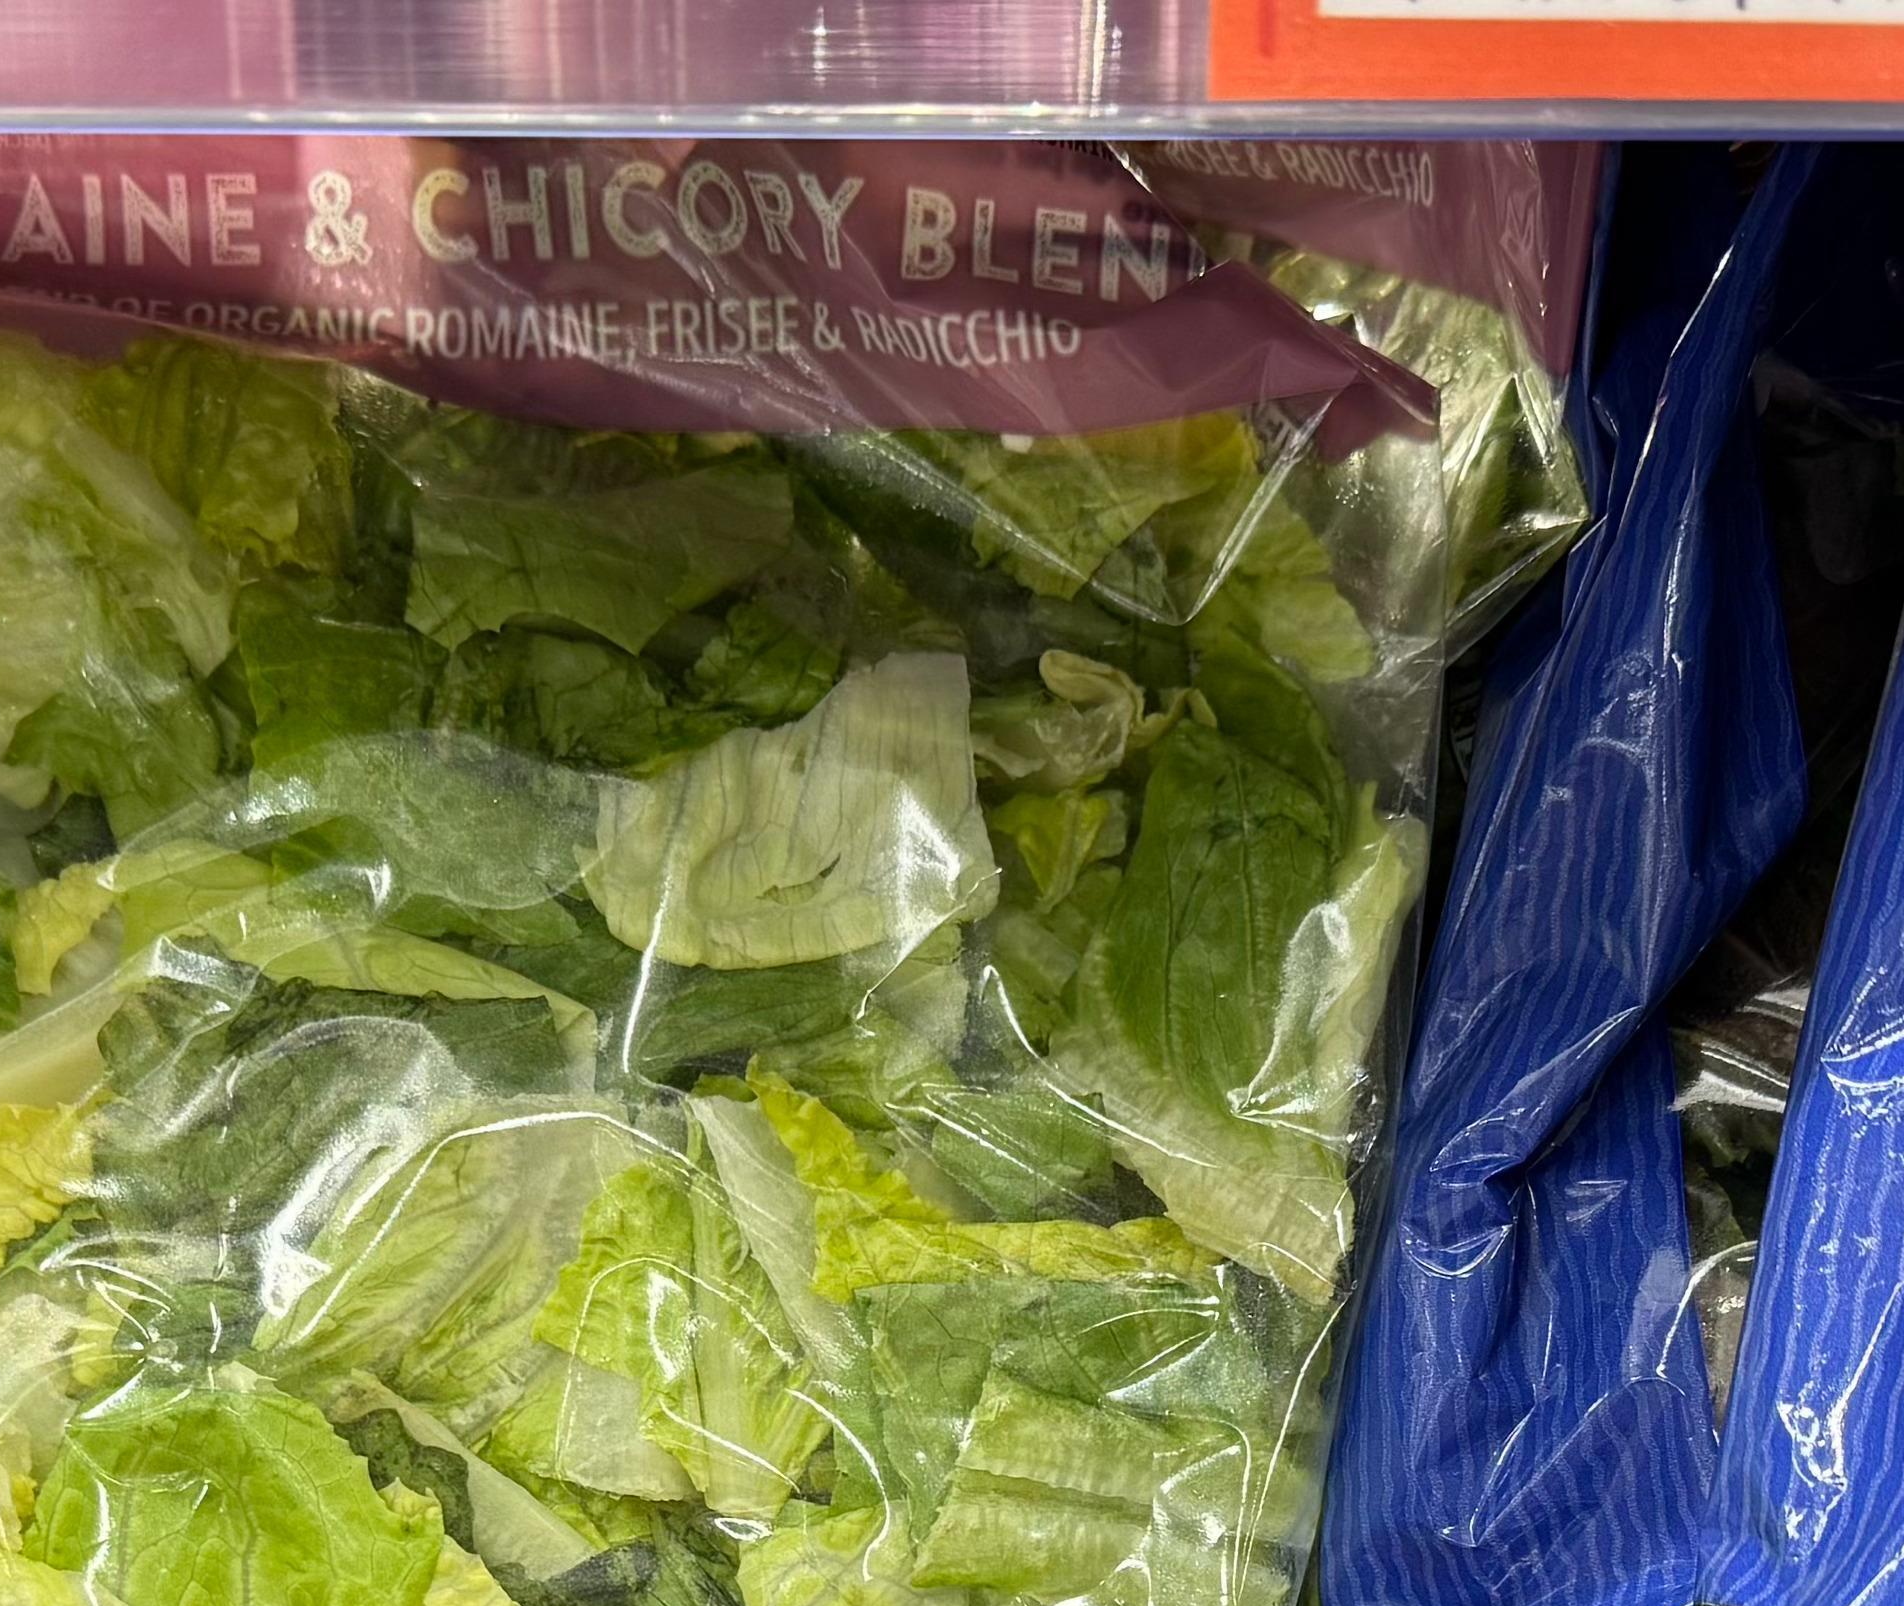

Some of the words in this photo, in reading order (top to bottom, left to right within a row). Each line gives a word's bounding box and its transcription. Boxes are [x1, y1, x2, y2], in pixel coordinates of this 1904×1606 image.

[1146, 140, 1251, 178] RISEE
[1284, 143, 1434, 208] RADICCHIO
[306, 170, 372, 267] &
[410, 163, 863, 273] CHICORY
[900, 186, 1208, 304] BLEN
[183, 300, 395, 347] ORGANIC
[405, 304, 637, 366] ROMAINE,
[646, 302, 799, 358] FRISEE
[814, 303, 845, 352] &
[860, 309, 1082, 367] RADICCHIO
